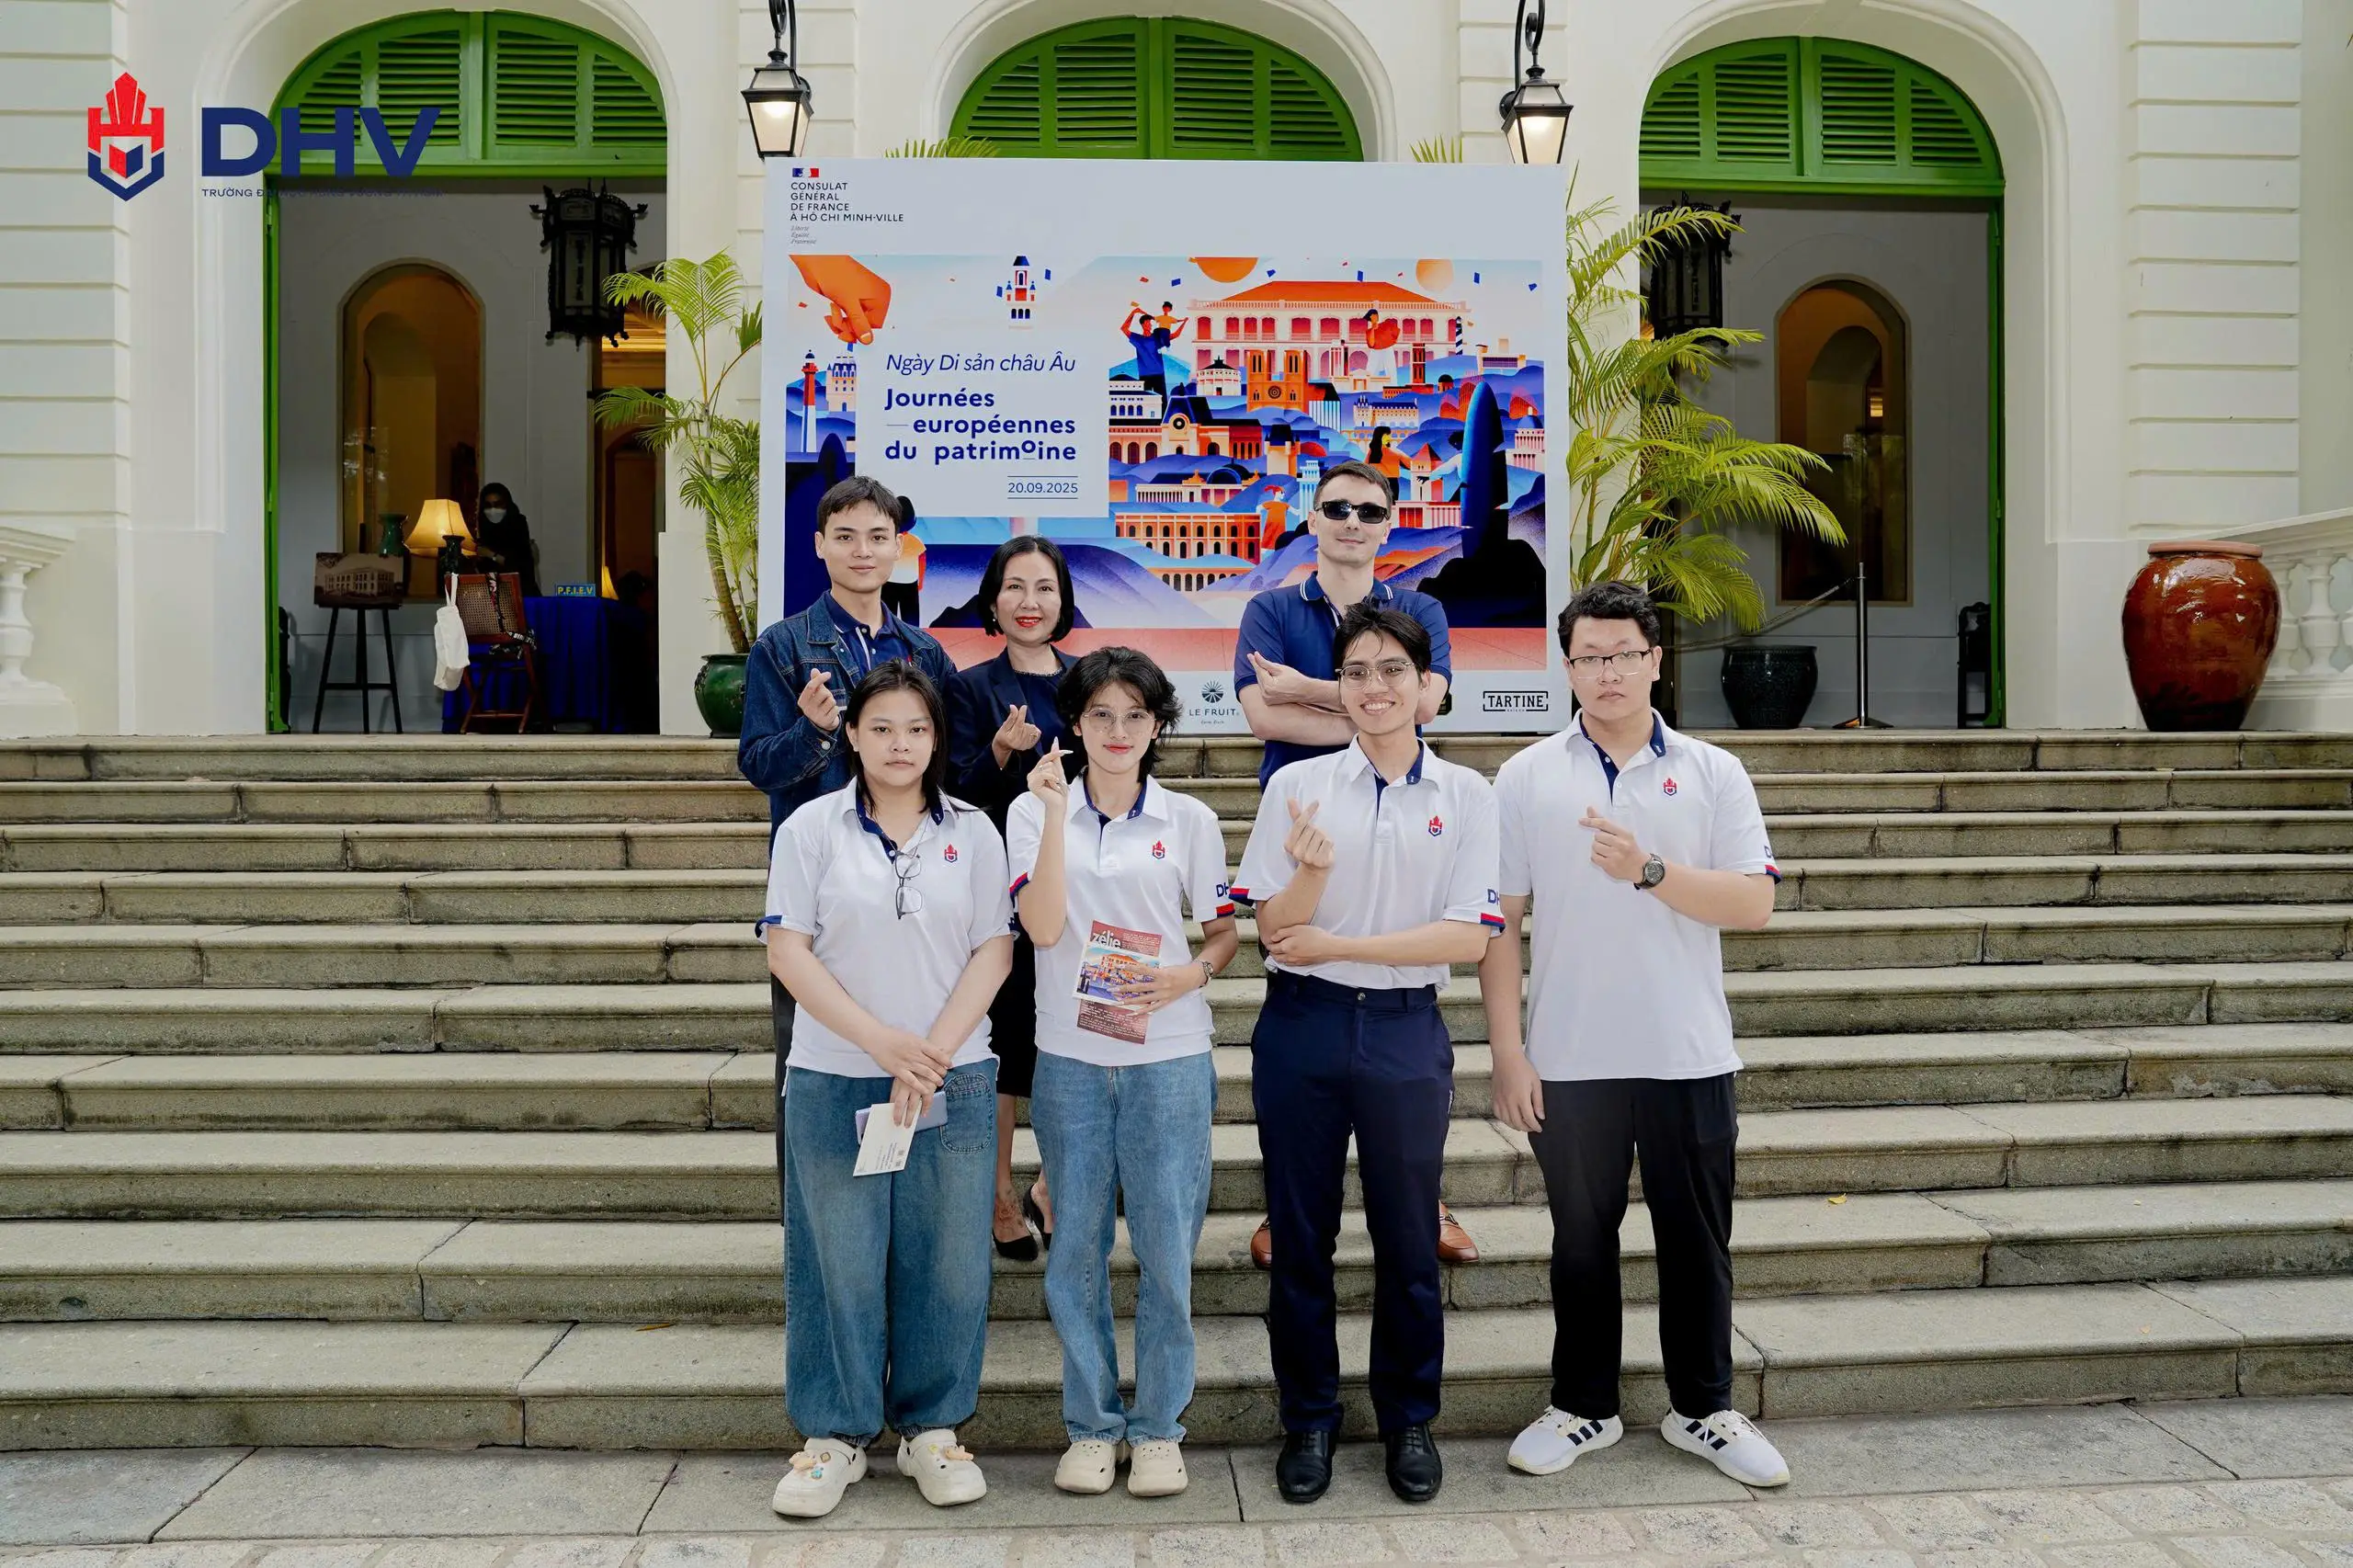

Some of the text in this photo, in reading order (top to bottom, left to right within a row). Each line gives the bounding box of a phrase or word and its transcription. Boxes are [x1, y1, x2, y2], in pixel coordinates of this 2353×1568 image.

[790, 182, 847, 190] CONSULAT
[790, 191, 839, 200] GÉNÉRAL
[821, 213, 839, 222] CHI
[843, 213, 904, 222] MINH-VILLE
[886, 350, 1076, 375] Ngày Di sản châu Âu
[884, 388, 995, 410] Journées
[913, 415, 1075, 438] européennes
[884, 440, 1076, 465] du patrimoine
[1007, 483, 1078, 493] 20.09.2025
[1487, 695, 1544, 708] TARTINE
[1204, 708, 1236, 716] FRUIT
[1092, 930, 1122, 949] zélie
